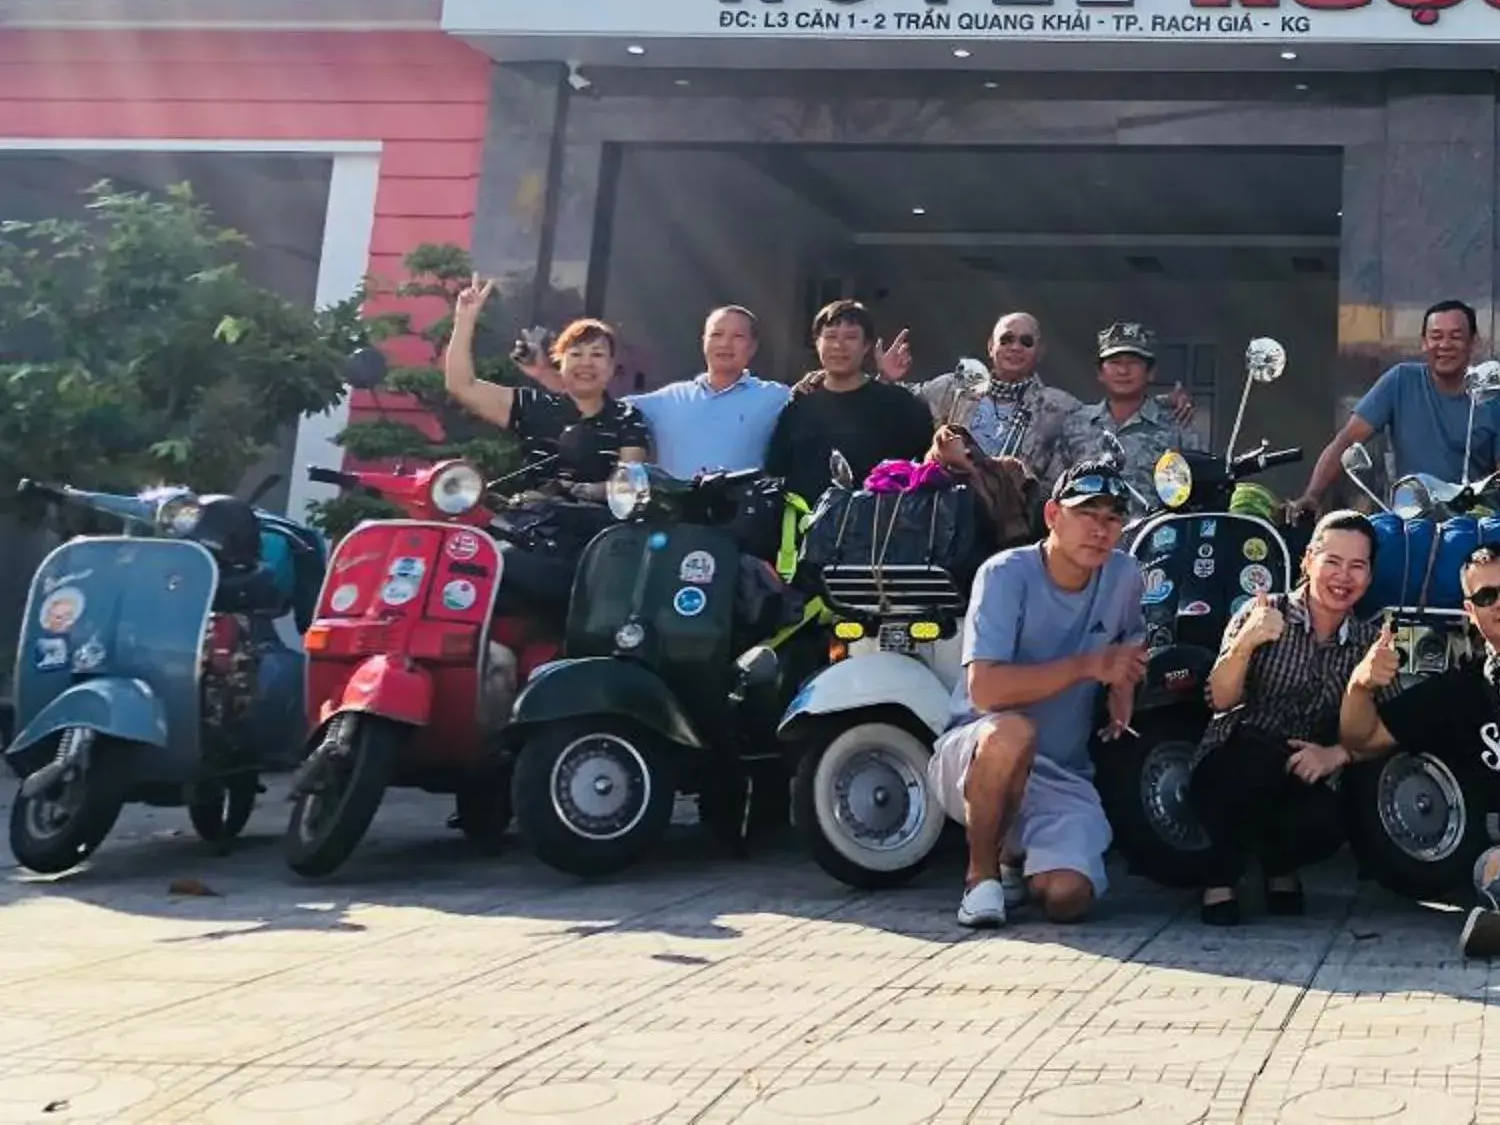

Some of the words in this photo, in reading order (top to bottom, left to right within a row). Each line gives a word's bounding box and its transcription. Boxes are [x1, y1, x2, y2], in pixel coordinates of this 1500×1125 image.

[719, 10, 757, 28] ĐC:
[763, 11, 789, 29] L3
[957, 12, 1035, 32] QUANG
[1112, 15, 1144, 32] TP.
[1280, 15, 1311, 33] KG
